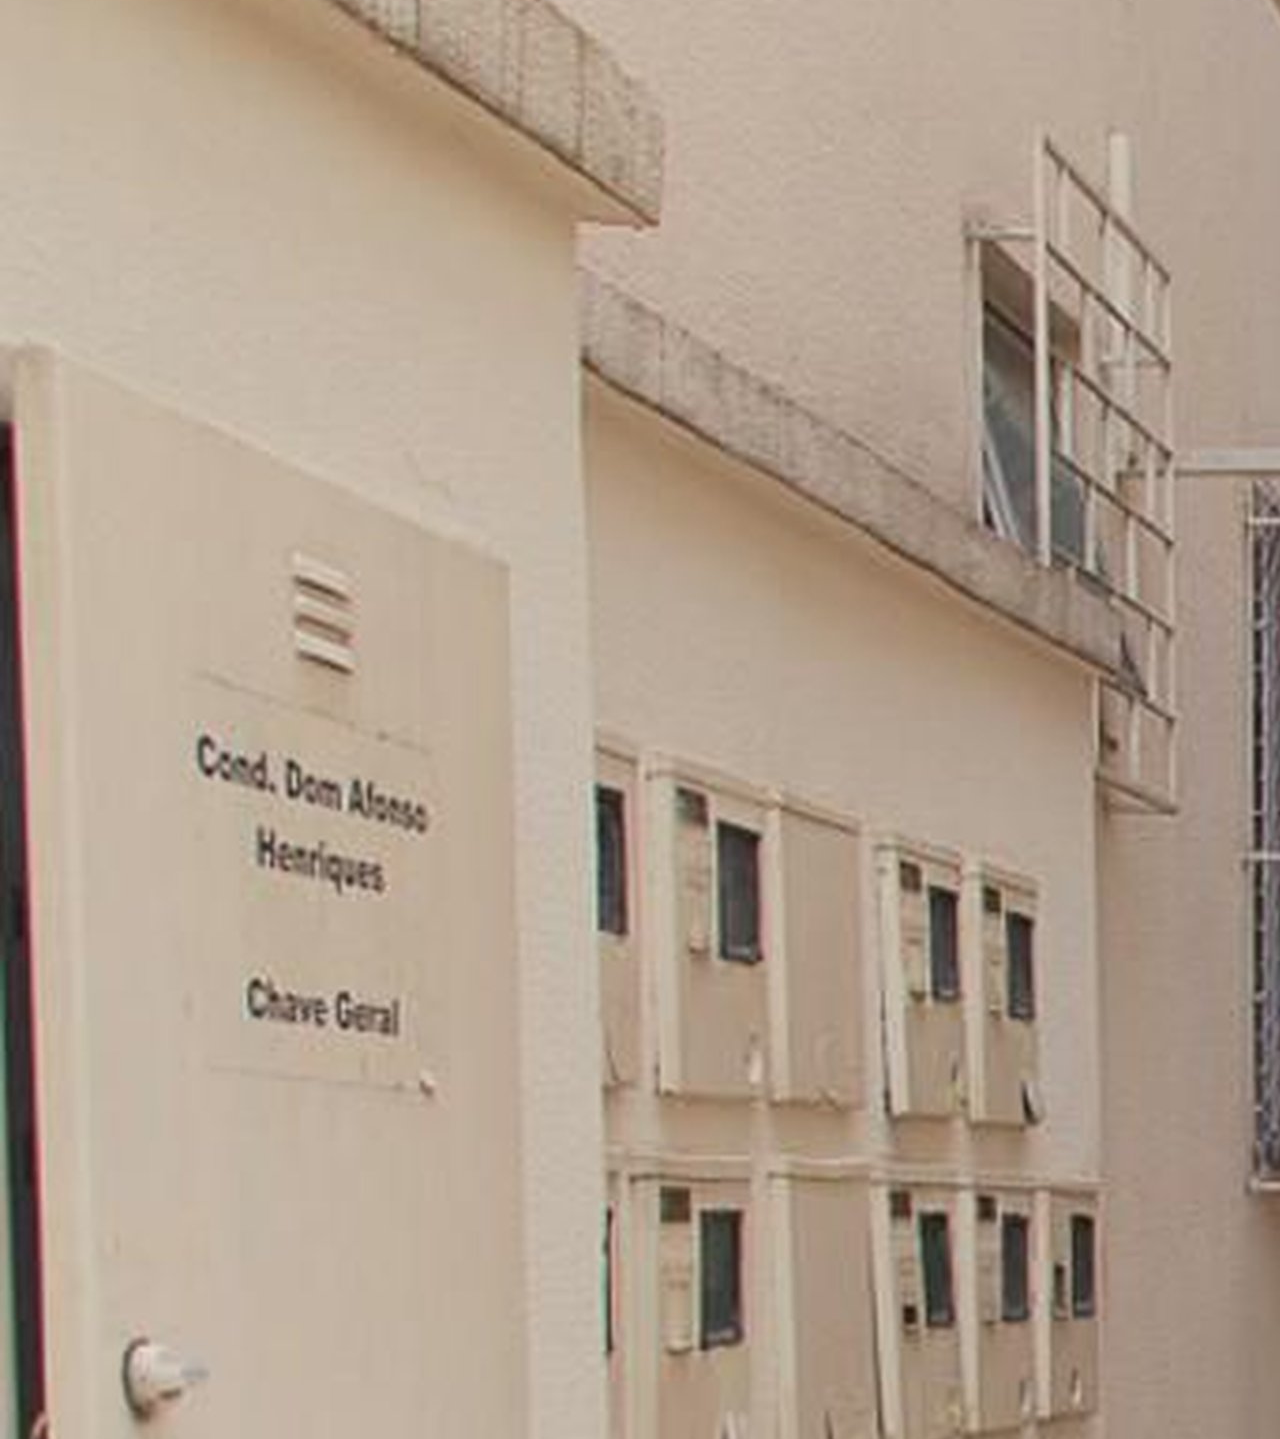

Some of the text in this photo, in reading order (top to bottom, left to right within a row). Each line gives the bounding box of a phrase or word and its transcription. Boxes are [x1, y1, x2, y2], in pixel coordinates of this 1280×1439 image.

[196, 734, 427, 833] Cond. Dom Afonso
[256, 825, 386, 895] Henriques
[247, 976, 399, 1037] Chave Geral
